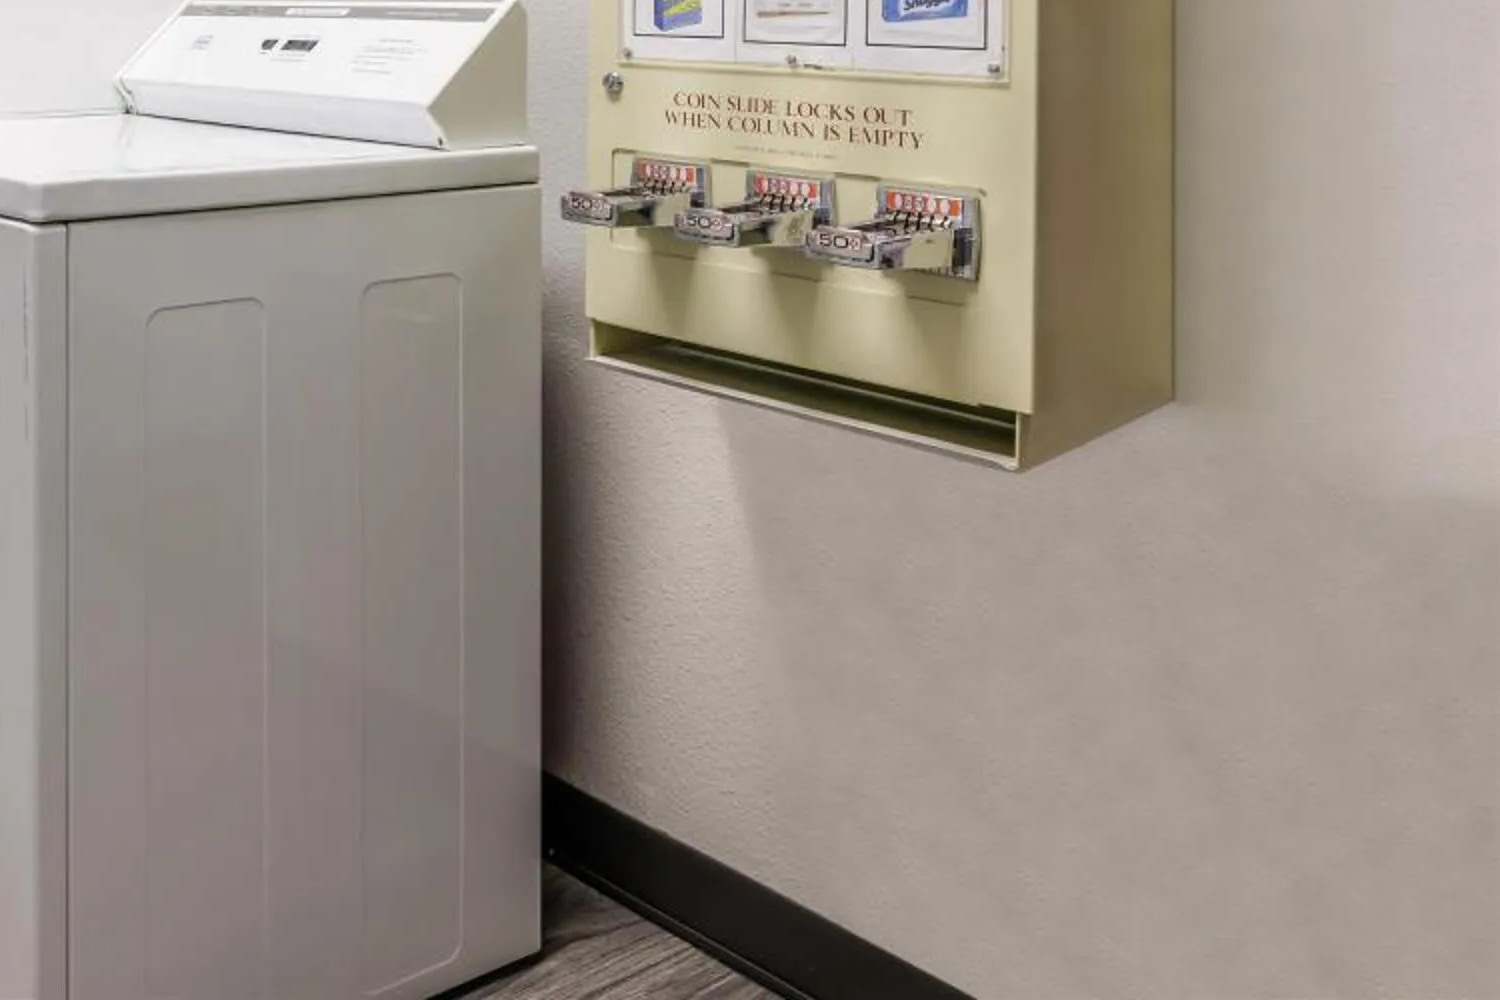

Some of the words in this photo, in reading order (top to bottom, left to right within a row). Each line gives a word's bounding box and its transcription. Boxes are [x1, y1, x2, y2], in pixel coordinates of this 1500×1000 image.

[673, 91, 721, 110] COIN
[727, 96, 776, 115] SLIDE
[786, 101, 856, 123] LOCKS
[863, 107, 913, 127] OUT
[665, 110, 721, 130] WHEN
[727, 116, 814, 139] COLUMN
[824, 124, 841, 141] IS
[849, 128, 924, 150] EMPTY
